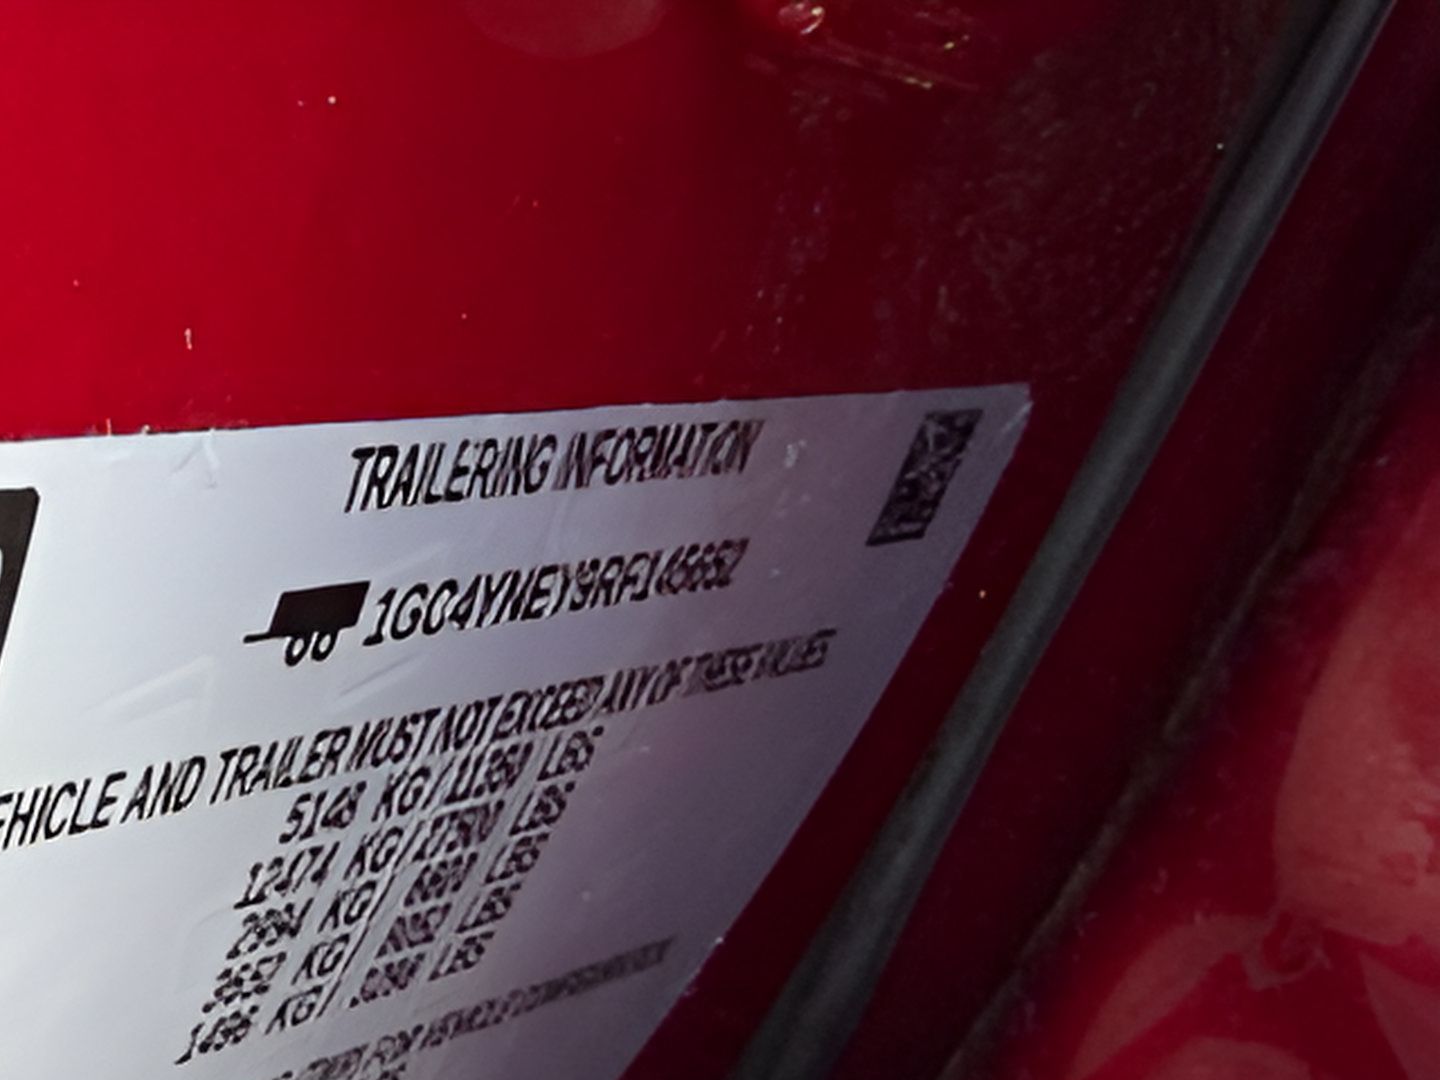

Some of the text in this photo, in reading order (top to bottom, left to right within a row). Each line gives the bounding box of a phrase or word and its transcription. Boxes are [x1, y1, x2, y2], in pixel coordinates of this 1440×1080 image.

[344, 418, 764, 513] TRAILERING INFORMATION
[120, 755, 207, 825] AND
[209, 725, 352, 805] TRAILER
[345, 708, 441, 772] MUST
[433, 694, 503, 756] NOT
